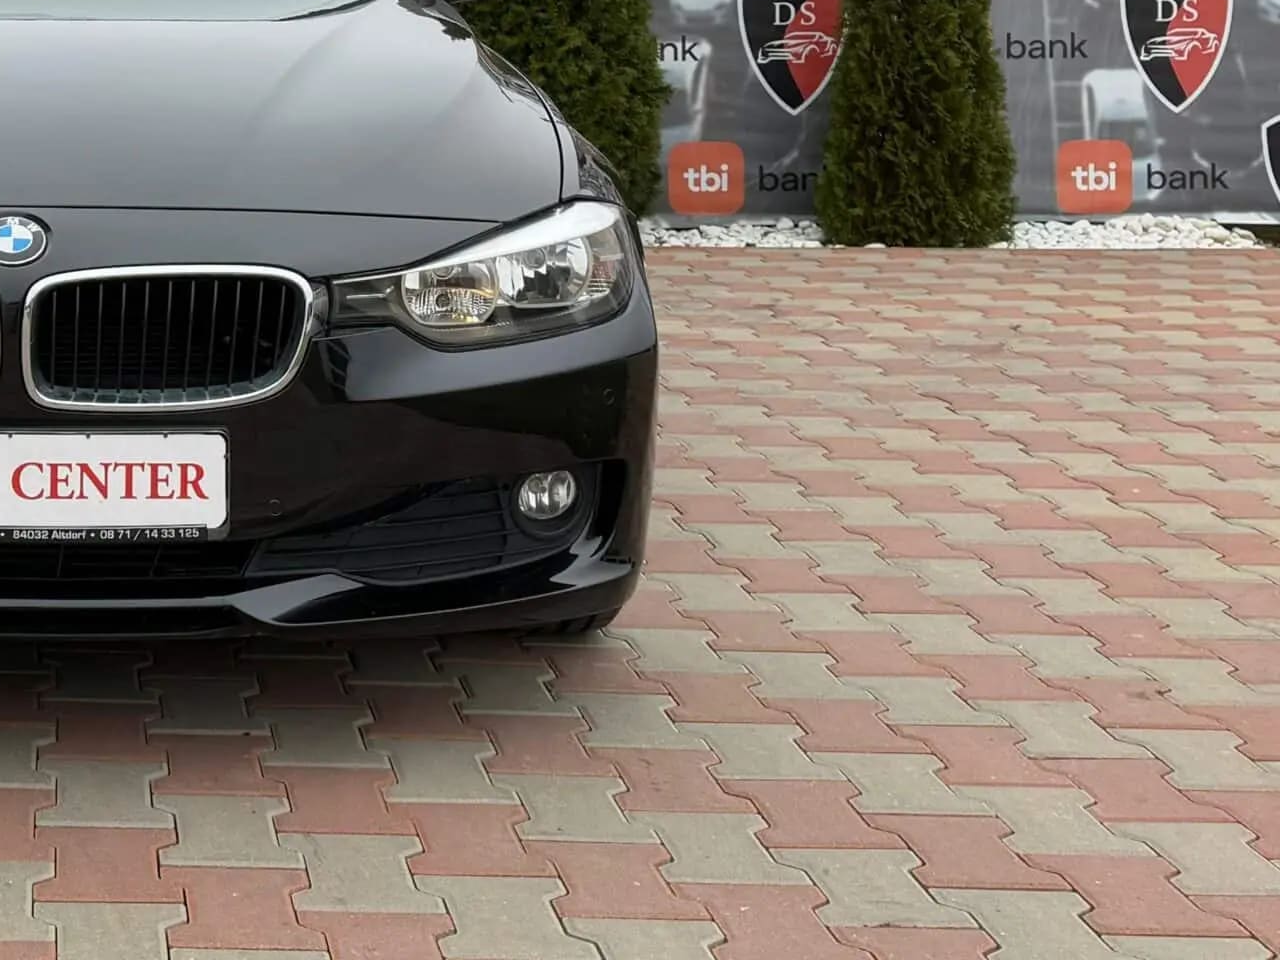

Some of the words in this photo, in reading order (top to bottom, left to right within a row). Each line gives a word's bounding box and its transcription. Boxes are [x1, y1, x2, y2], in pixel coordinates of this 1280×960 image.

[772, 1, 817, 26] DS
[660, 35, 699, 61] nk
[1005, 32, 1089, 59] bank
[683, 163, 729, 192] tbi
[758, 165, 827, 191] ban
[1071, 161, 1117, 191] tbi
[1146, 163, 1230, 190] bank
[10, 461, 209, 500] CENTER
[12, 529, 49, 540] 84032
[51, 529, 87, 540] Altdorf
[99, 530, 114, 539] 08
[117, 529, 132, 539] 71
[144, 529, 158, 539] 14
[160, 529, 176, 538] 33
[178, 528, 200, 538] 125
